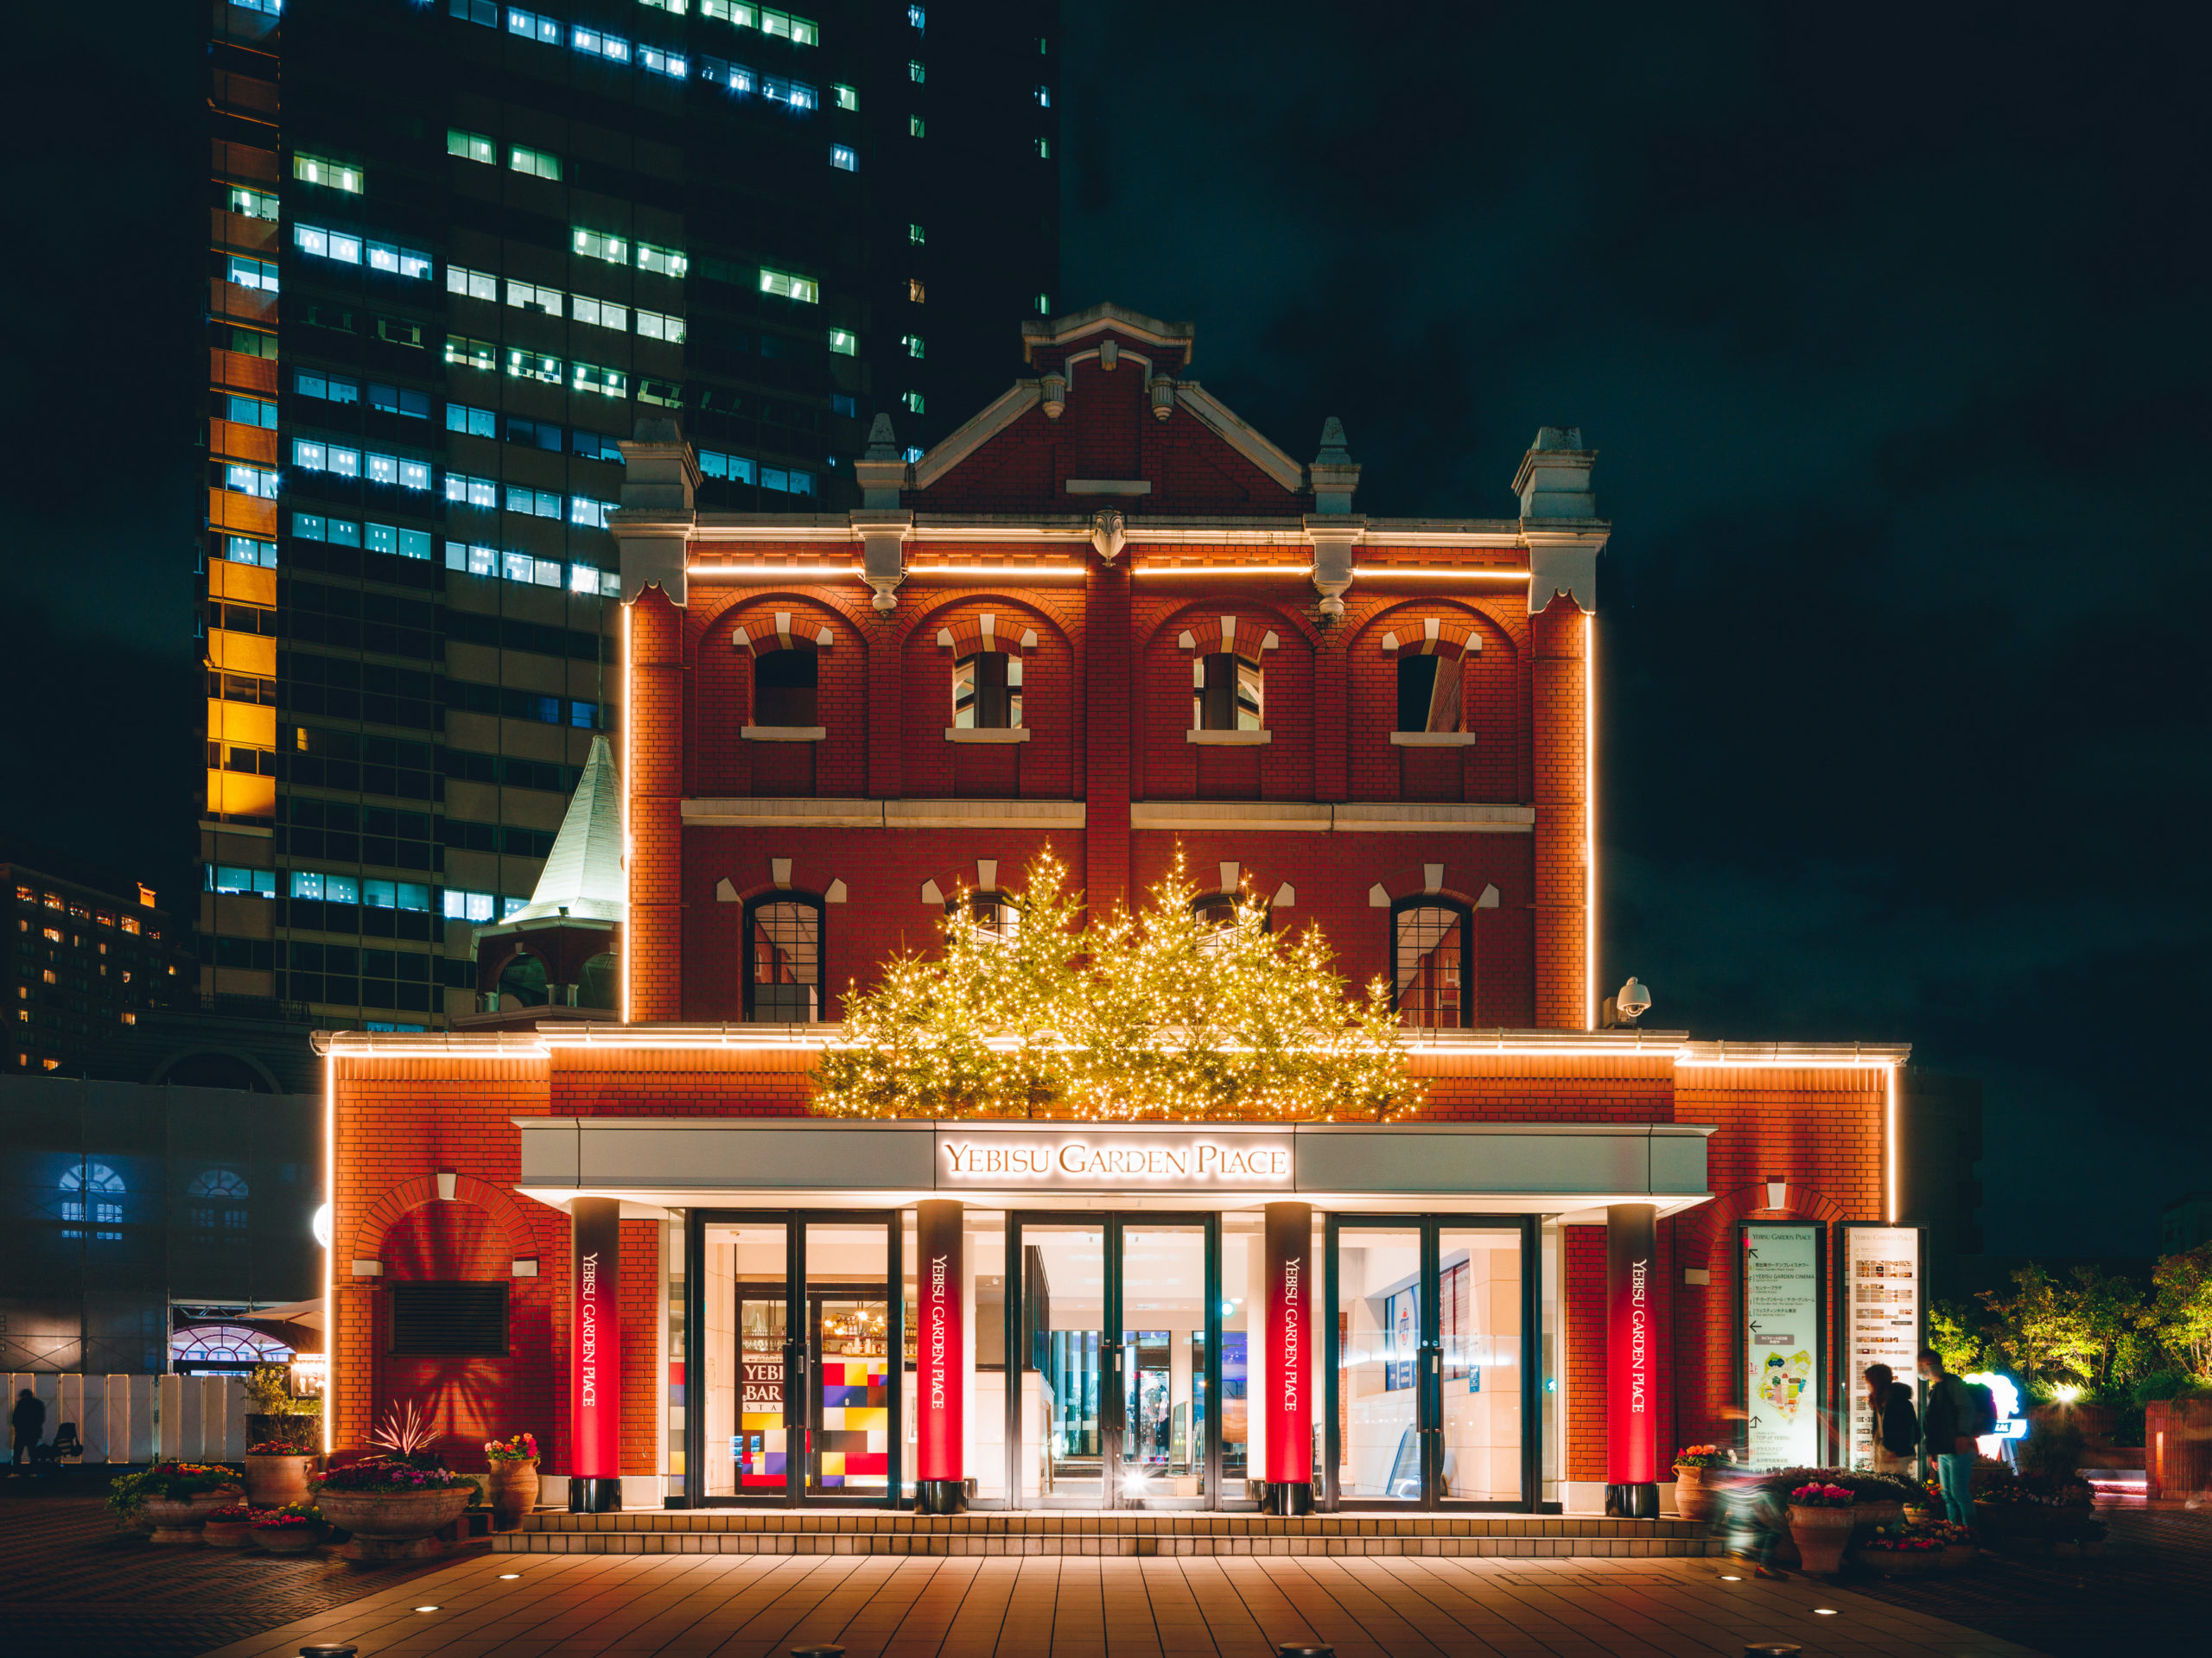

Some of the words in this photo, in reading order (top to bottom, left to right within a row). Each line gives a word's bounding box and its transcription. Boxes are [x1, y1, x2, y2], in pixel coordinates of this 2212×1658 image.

[944, 1144, 1050, 1172] YEBISU
[1058, 1145, 1185, 1173] GARDEN
[1194, 1145, 1286, 1174] PLACE
[583, 1252, 598, 1302] YEBISU
[932, 1255, 948, 1304] YEBISU
[1285, 1257, 1300, 1306] YEBISU
[1632, 1258, 1648, 1308] YEBISU
[582, 1305, 595, 1363] GARDEN
[931, 1306, 945, 1366] GARDEN
[1285, 1309, 1298, 1368] GARDEN
[1632, 1310, 1645, 1369] GARDEN
[582, 1366, 595, 1407] PLACE
[745, 1385, 783, 1401] BAR
[931, 1369, 944, 1409] PLACE
[1284, 1371, 1298, 1411] PLACE
[1632, 1372, 1644, 1413] PLACE
